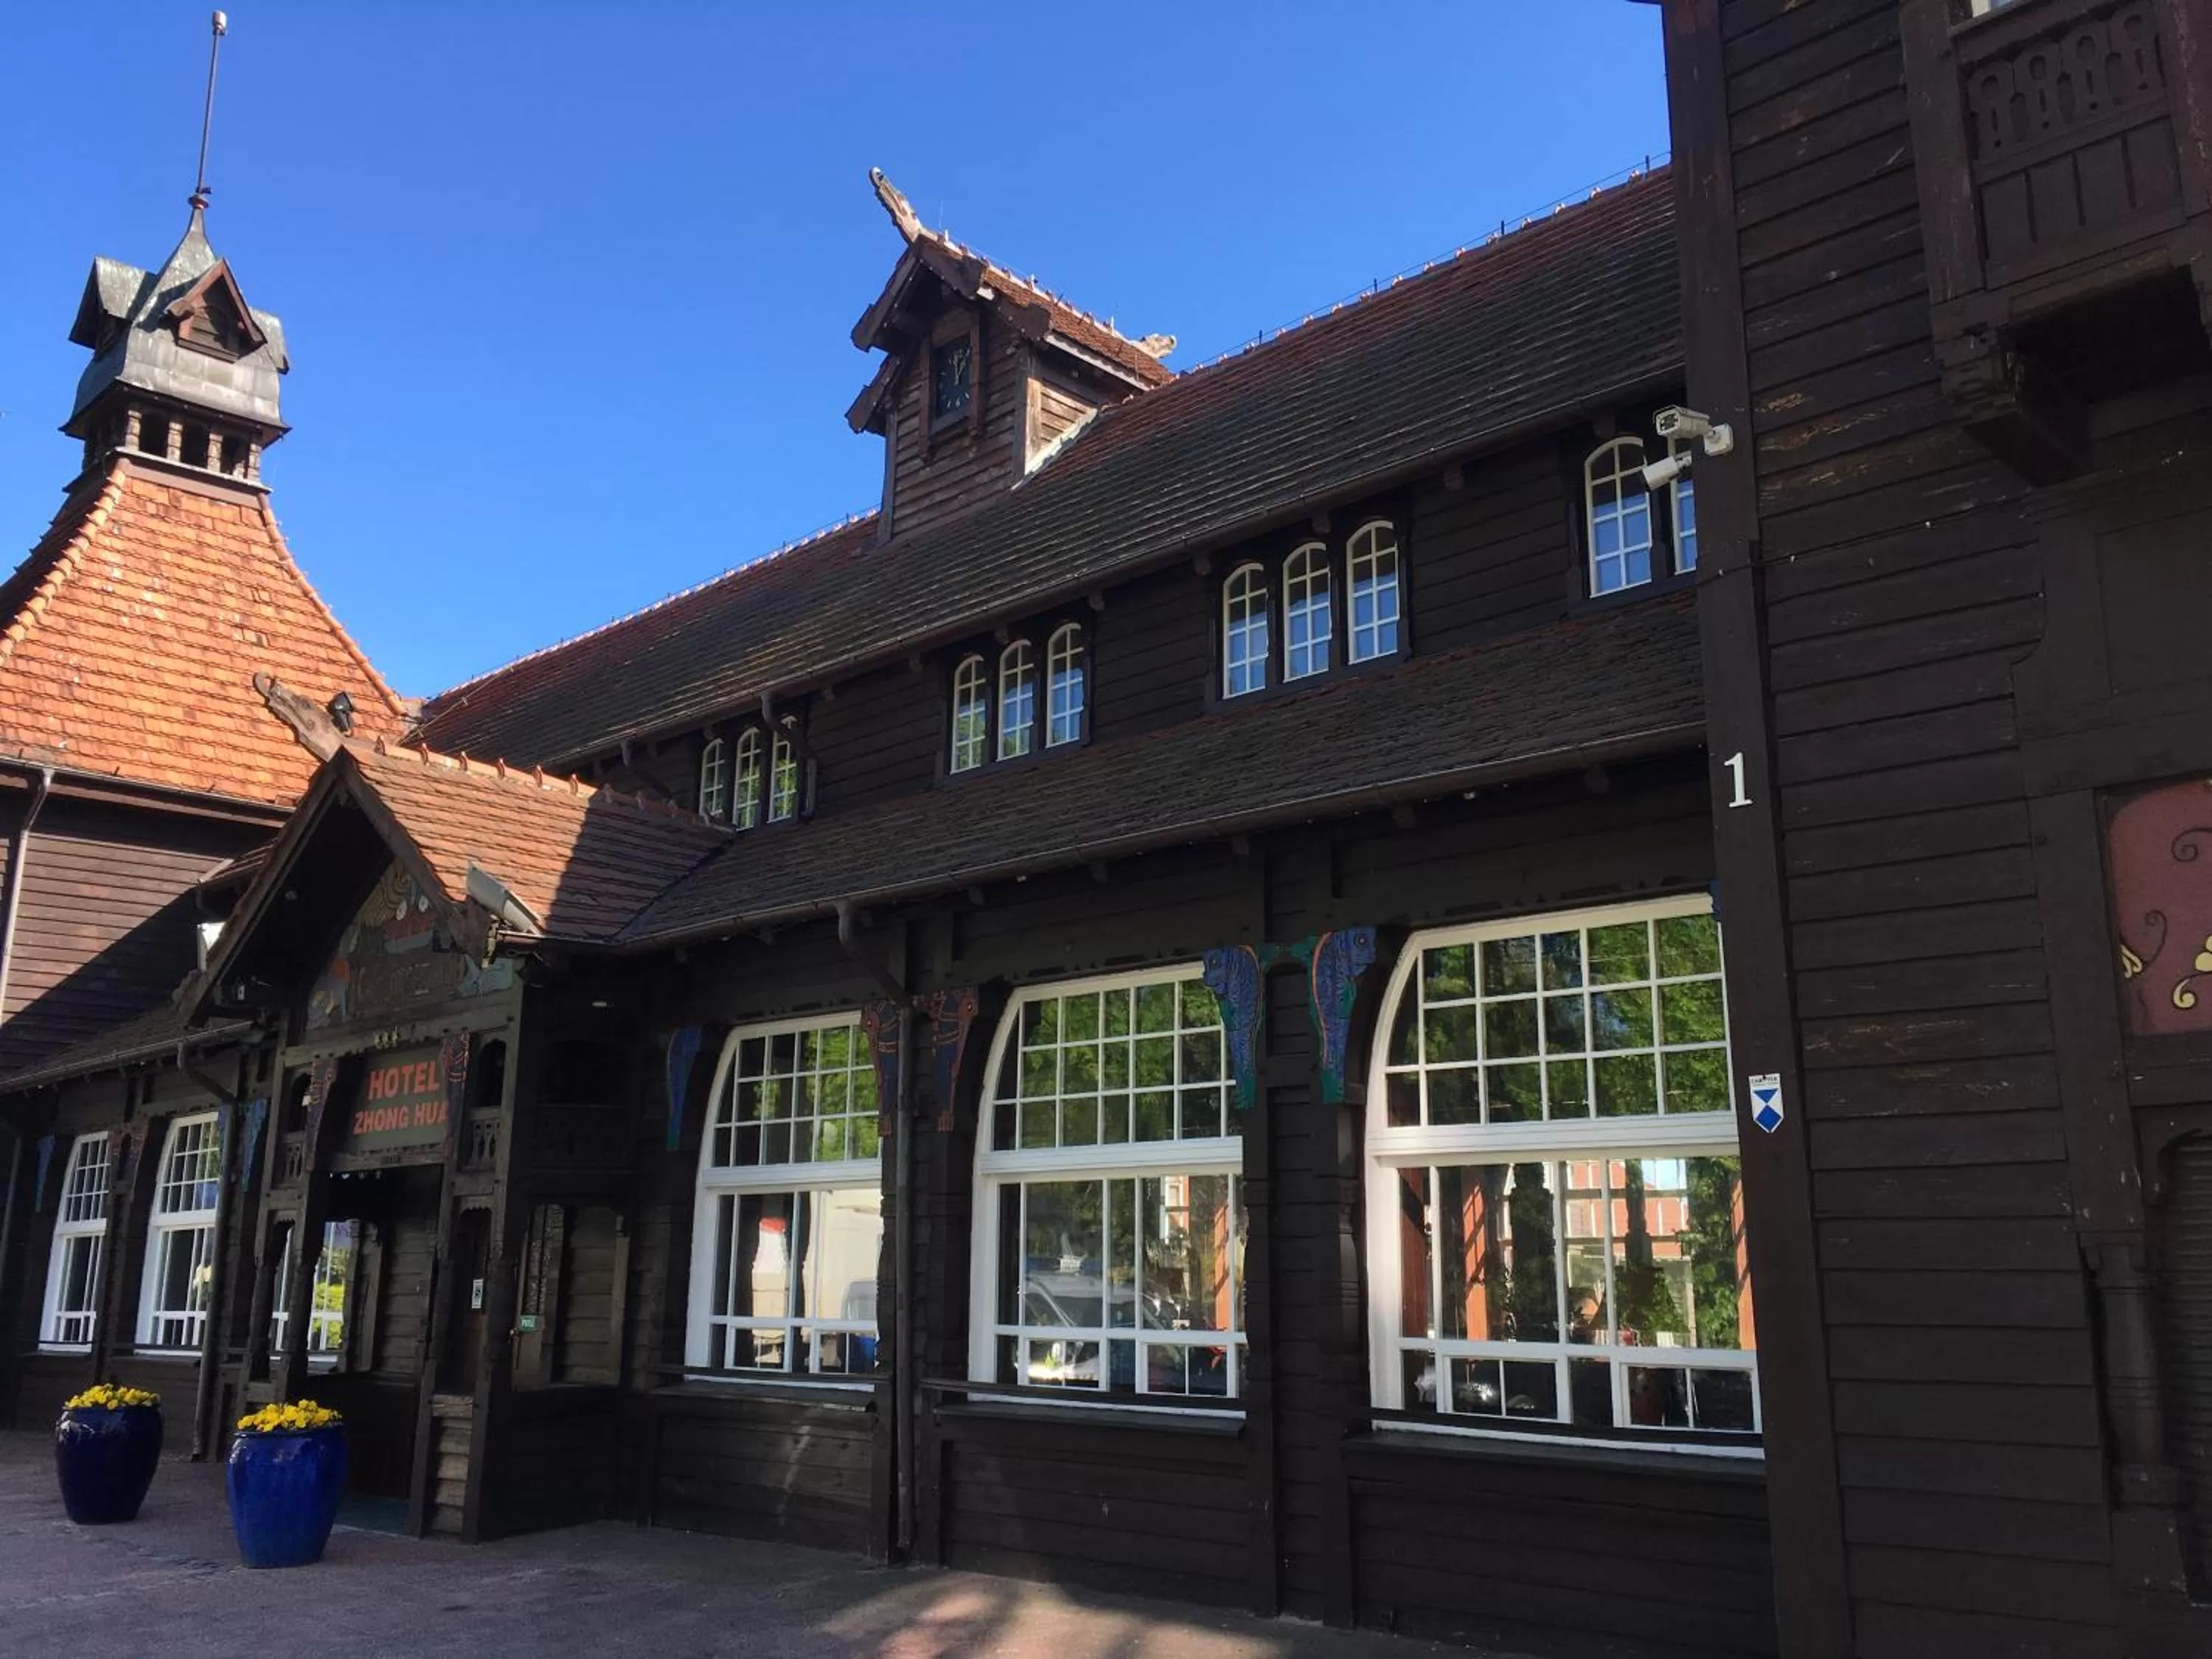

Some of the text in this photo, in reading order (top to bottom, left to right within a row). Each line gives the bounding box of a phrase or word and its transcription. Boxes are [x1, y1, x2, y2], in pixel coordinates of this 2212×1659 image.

[1723, 751, 1753, 807] 1
[368, 1061, 440, 1101] HOTEL
[353, 1106, 409, 1135] ZHONG
